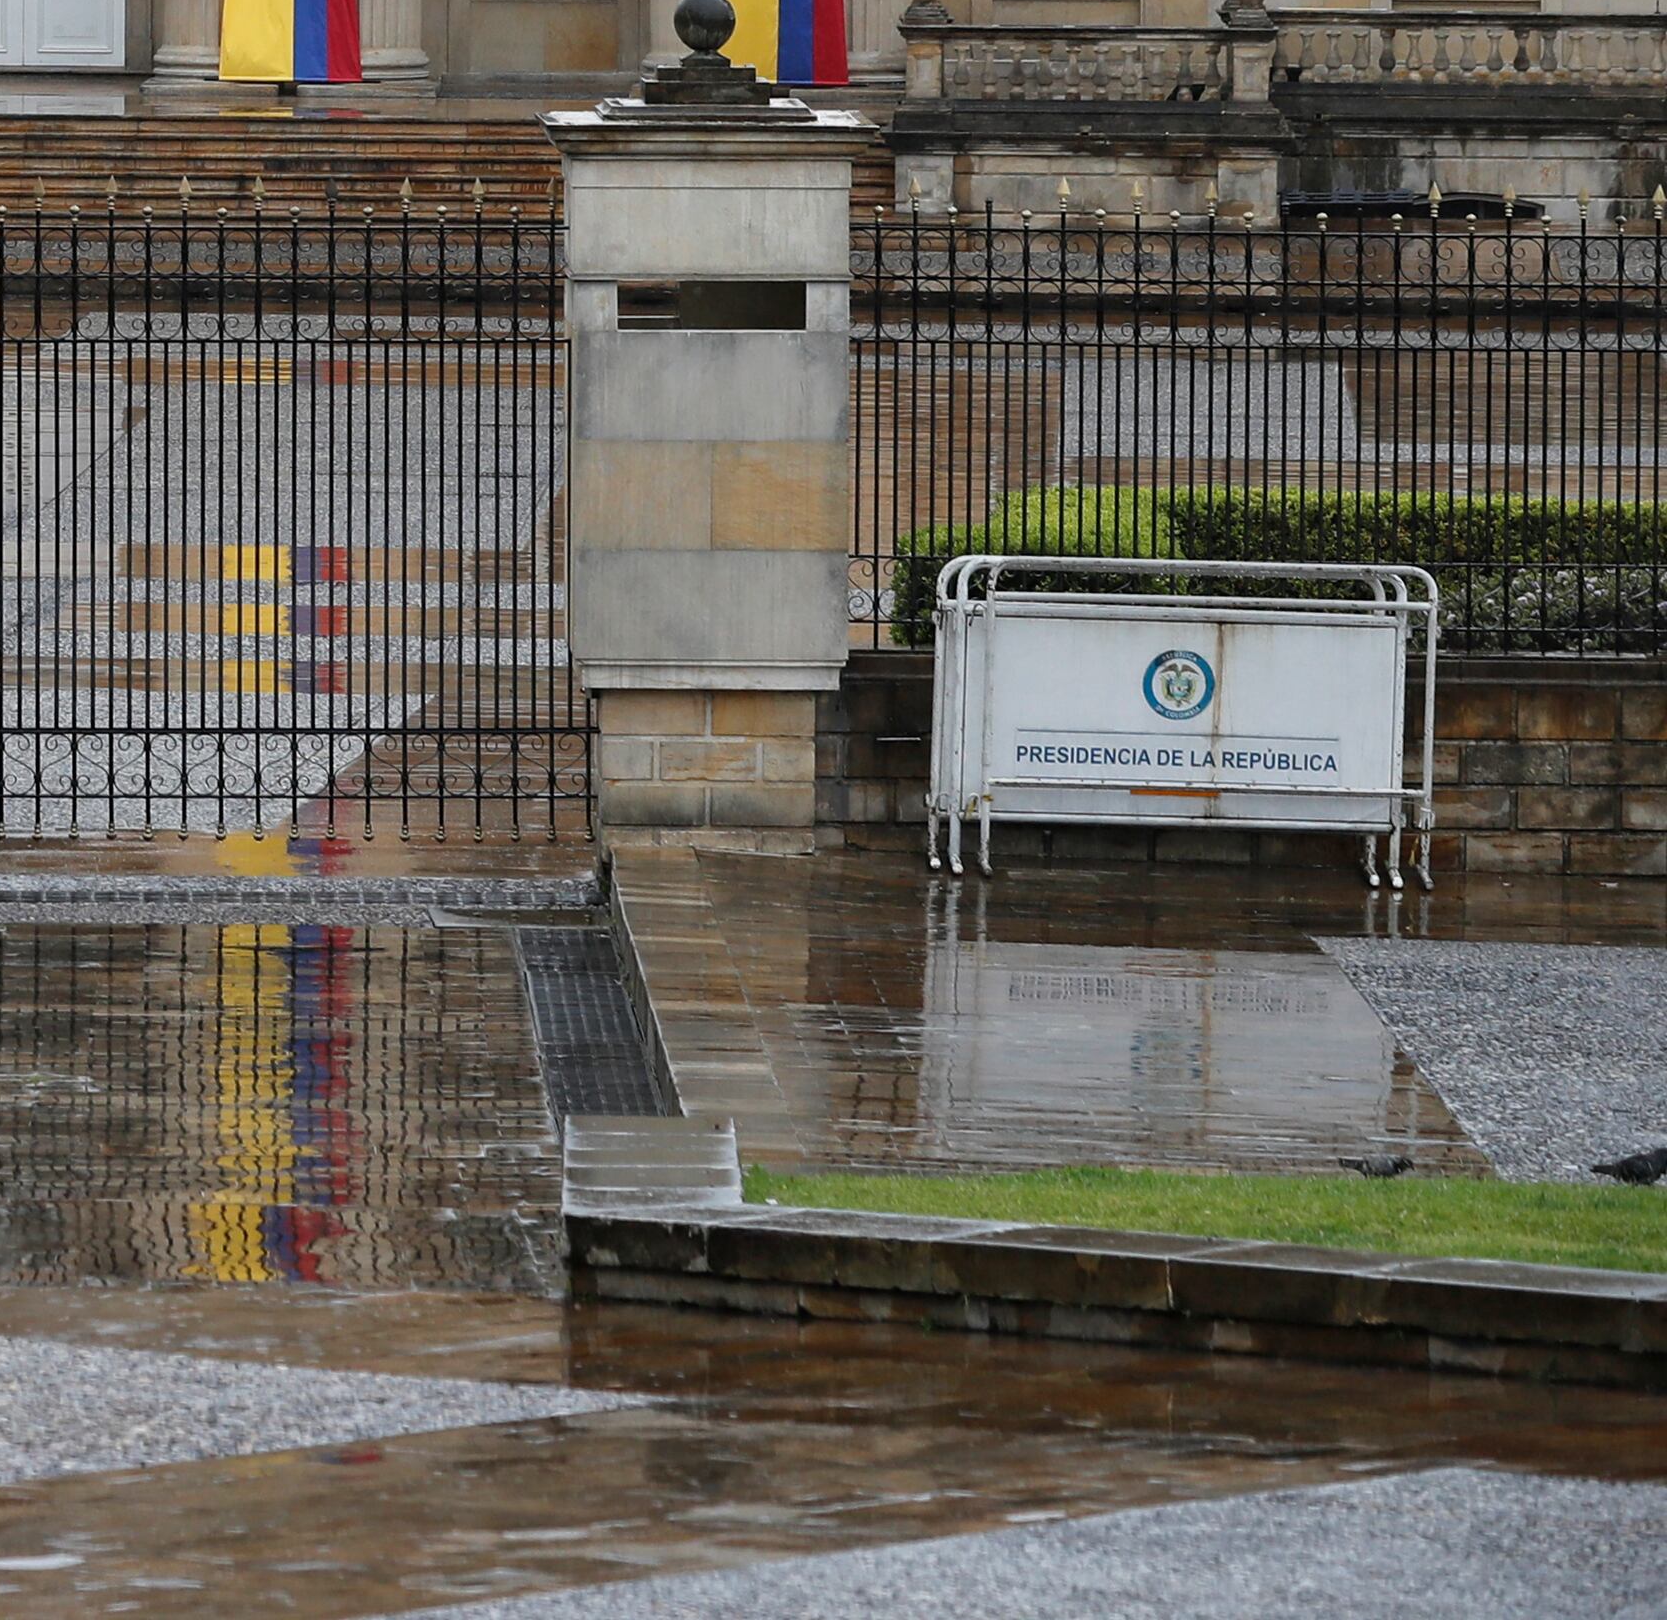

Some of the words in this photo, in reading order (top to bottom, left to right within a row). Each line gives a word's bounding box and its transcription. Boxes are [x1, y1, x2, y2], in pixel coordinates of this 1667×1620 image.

[1016, 745, 1151, 766] PRESIDENCIA
[1157, 749, 1184, 767] DE
[1190, 750, 1216, 768] LA
[1221, 747, 1338, 771] REPÚBLICA
